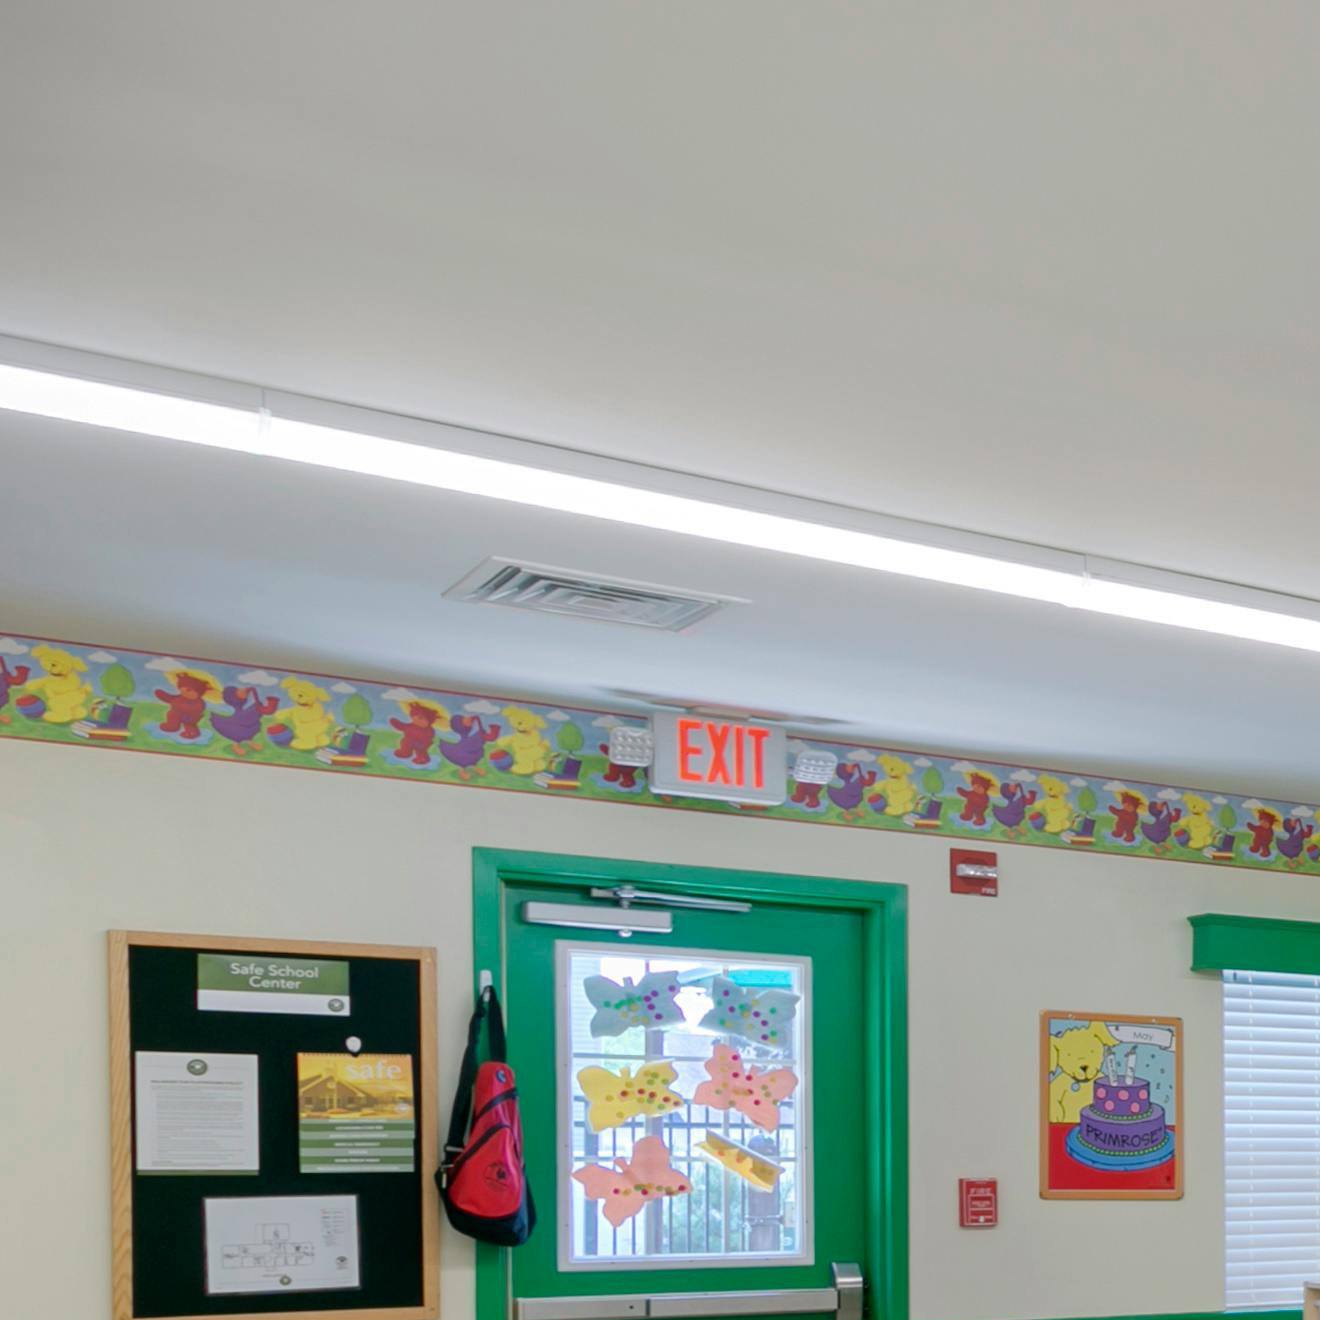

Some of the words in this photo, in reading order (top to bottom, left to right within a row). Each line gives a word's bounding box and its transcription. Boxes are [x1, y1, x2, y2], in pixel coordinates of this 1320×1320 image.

[677, 719, 770, 790] EXIT
[230, 962, 264, 976] Safe
[267, 964, 319, 979] School
[248, 975, 302, 990] Center
[1132, 1030, 1154, 1043] May
[346, 1058, 402, 1081] safe
[1086, 1123, 1161, 1149] PRIMROSE
